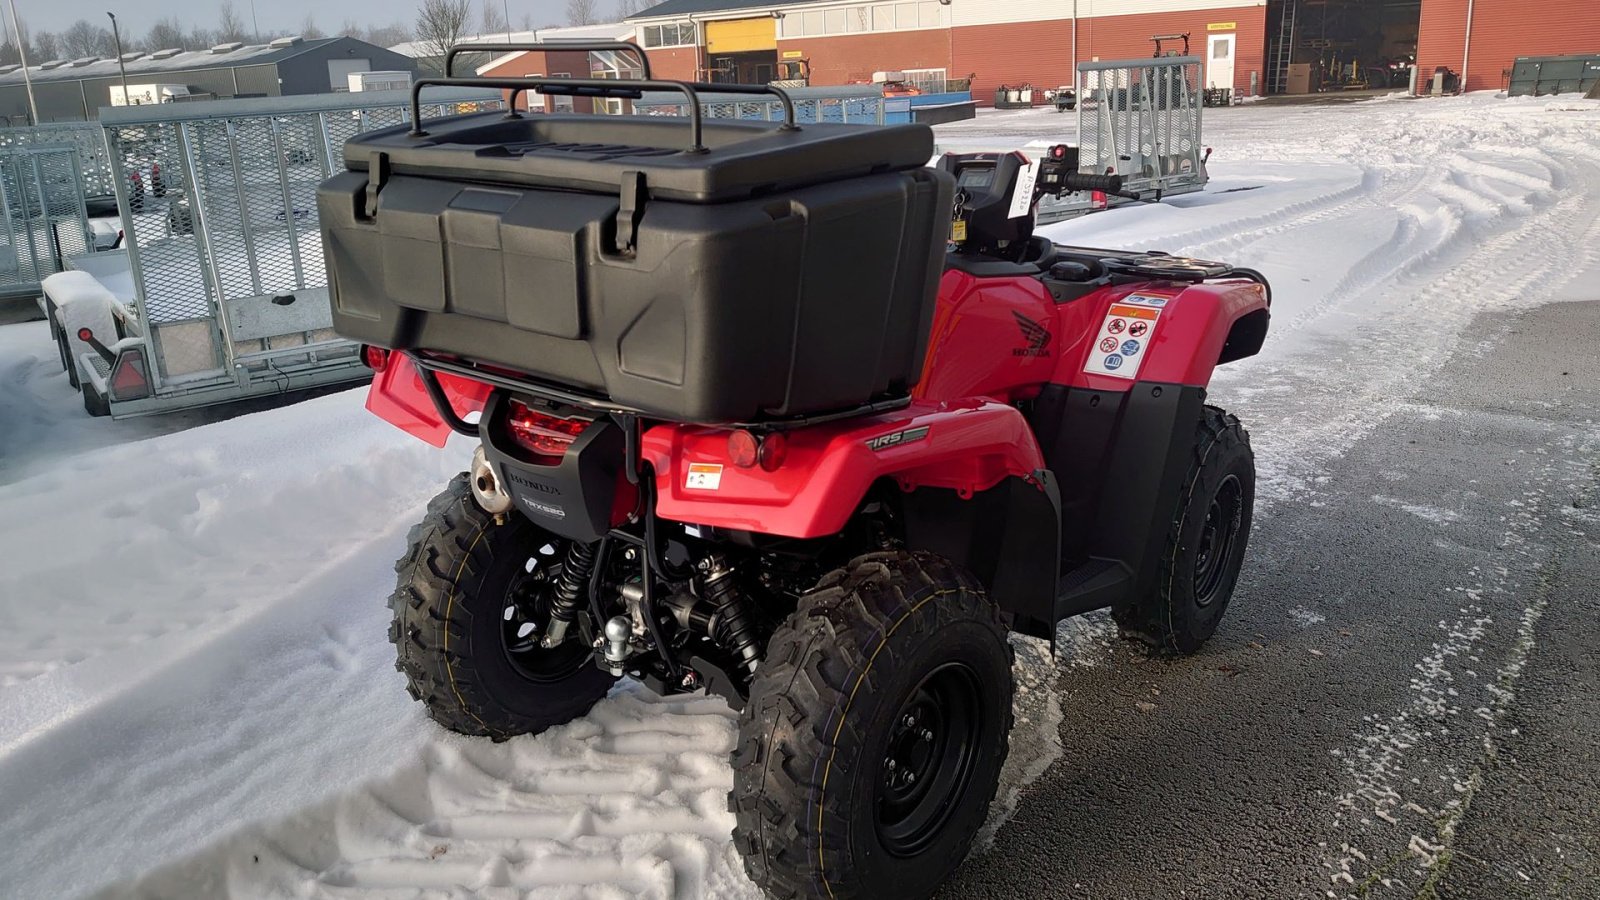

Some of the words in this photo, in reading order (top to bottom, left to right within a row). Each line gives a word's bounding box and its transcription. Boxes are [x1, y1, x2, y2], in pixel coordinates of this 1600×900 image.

[1012, 348, 1050, 357] HONDA
[873, 431, 903, 448] IRS
[510, 473, 561, 496] HONDA
[521, 497, 566, 517] TRX520
